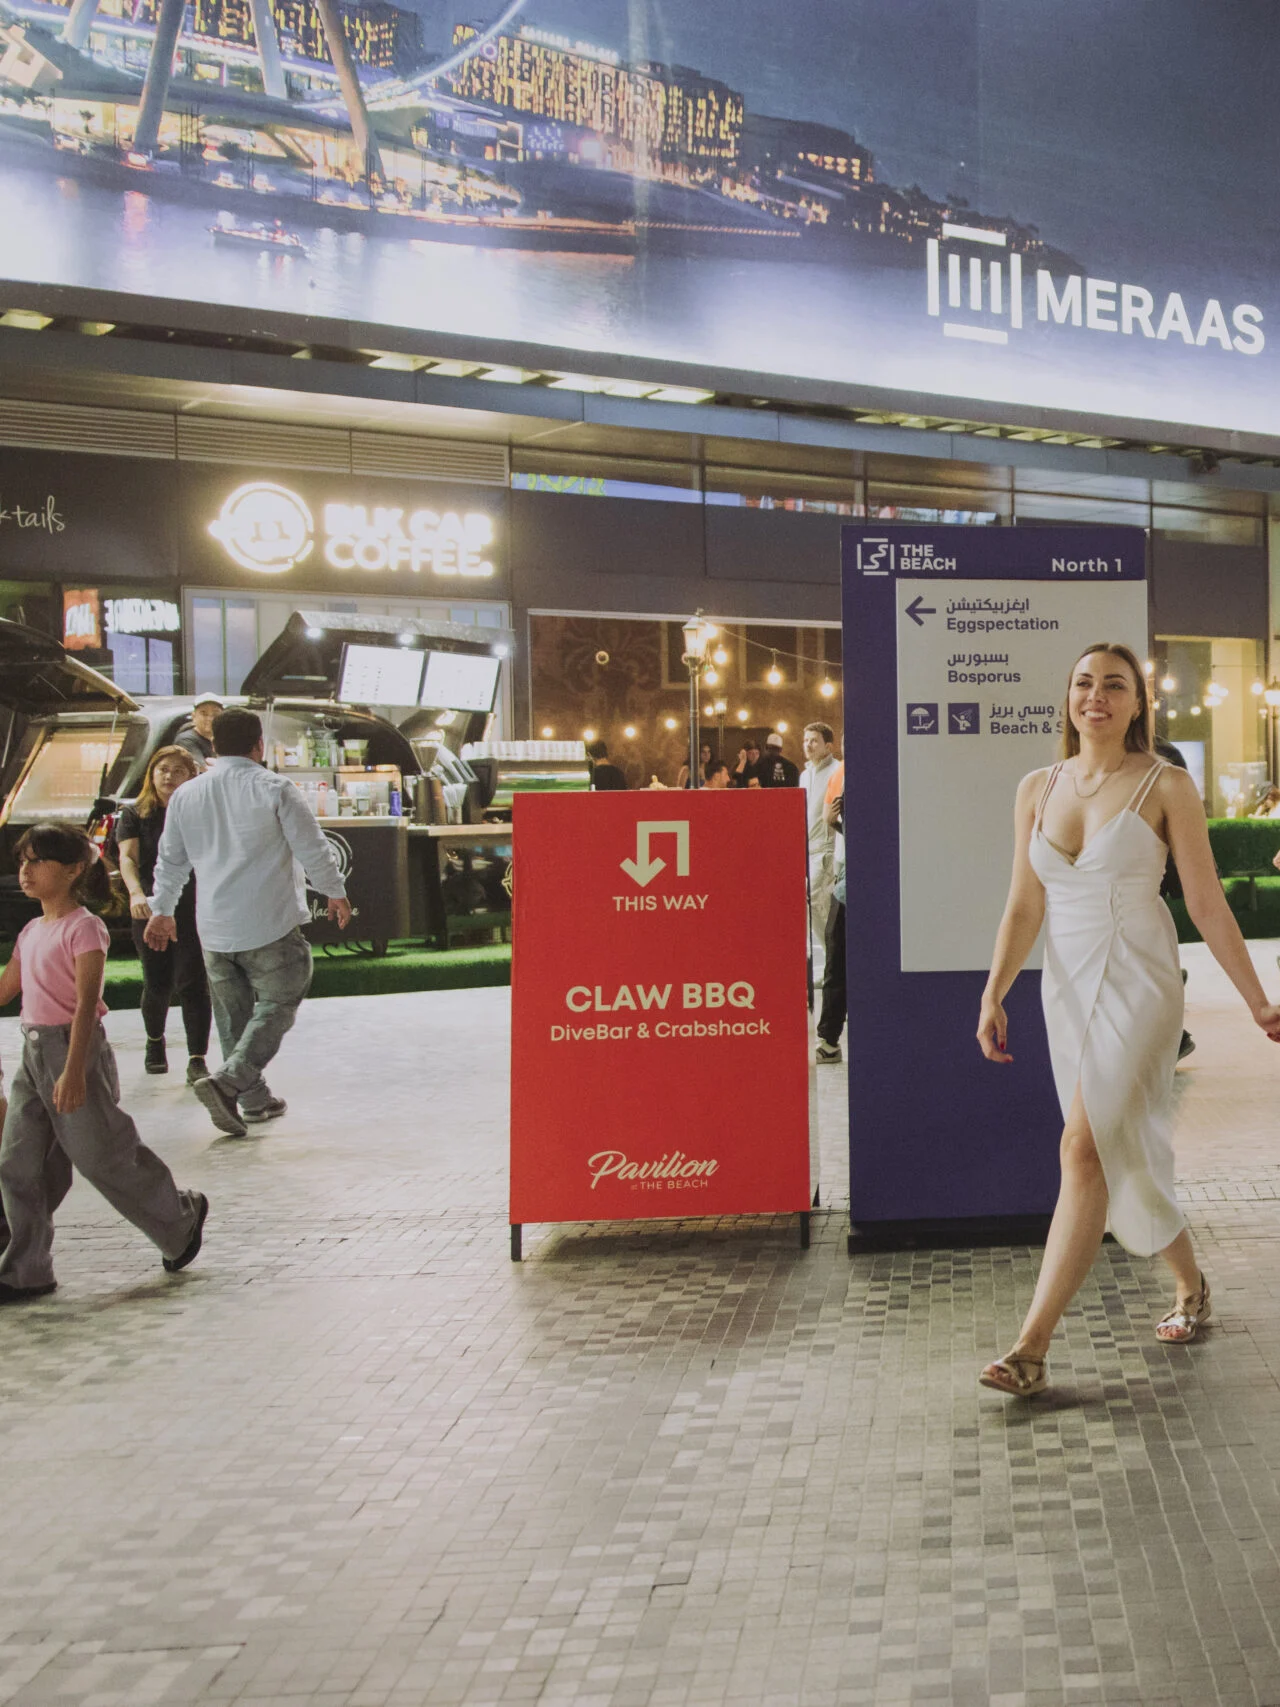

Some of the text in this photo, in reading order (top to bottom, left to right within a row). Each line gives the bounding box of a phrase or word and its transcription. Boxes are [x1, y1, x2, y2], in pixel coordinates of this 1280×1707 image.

[1037, 269, 1266, 355] MERAAS
[901, 544, 934, 557] THE
[901, 557, 957, 571] BEACH
[1052, 558, 1123, 573] North 1
[947, 618, 1059, 633] Eggspectation
[948, 670, 1021, 685] Bosporus
[991, 721, 1038, 735] Beach
[1042, 721, 1052, 734] &
[612, 894, 709, 911] THIS WAY
[566, 981, 755, 1012] CLAW BBQ
[550, 1018, 771, 1041] DiveBar & Crabshack
[588, 1150, 720, 1190] Pavilion
[640, 1181, 662, 1190] THE
[667, 1179, 708, 1190] BEACH
